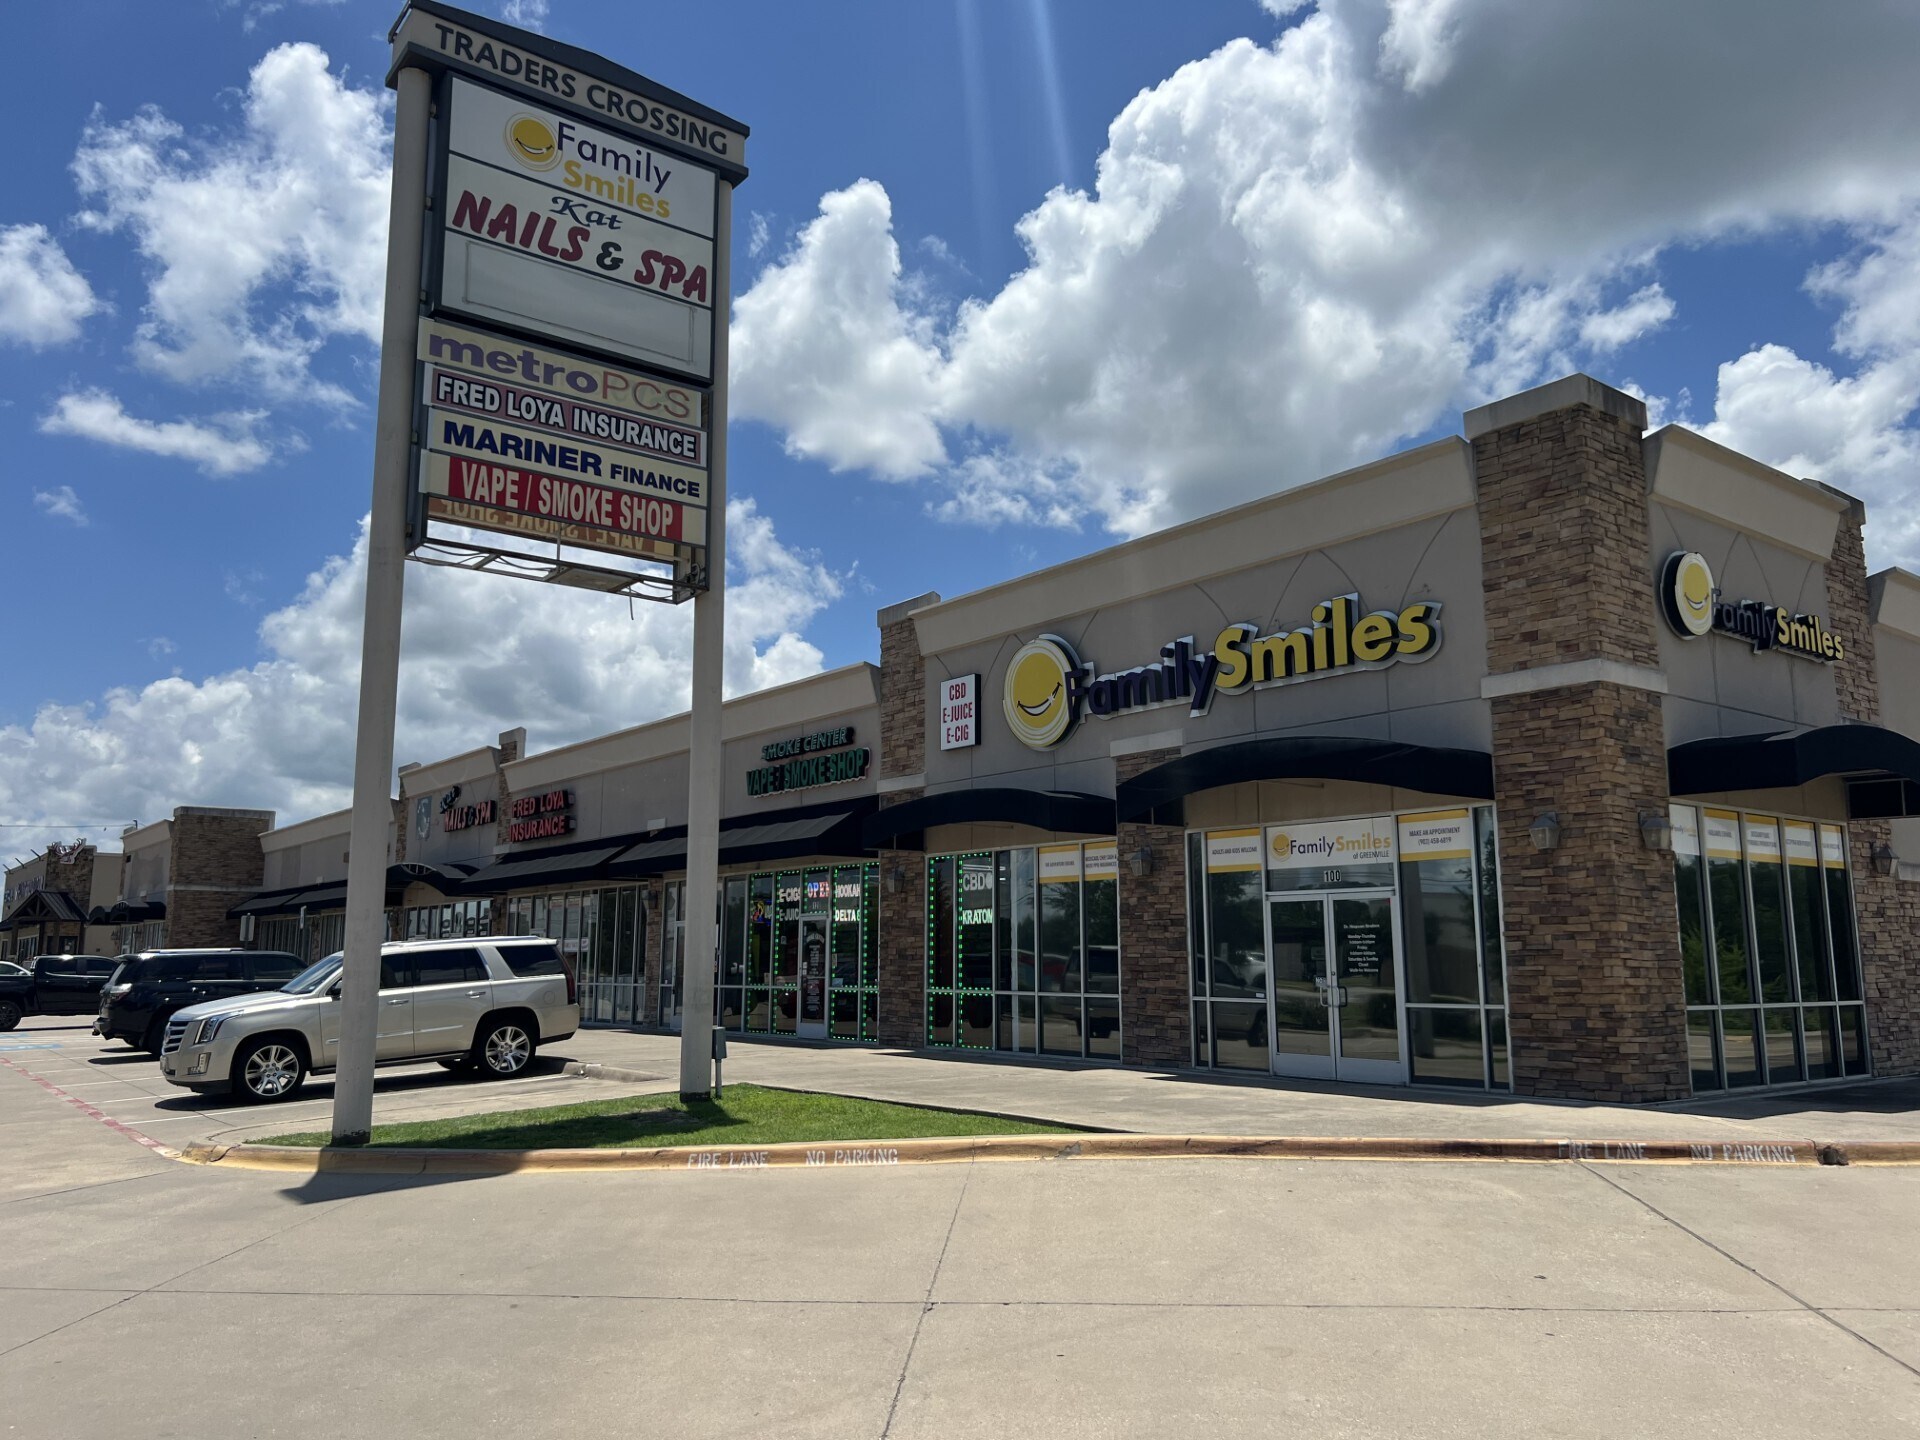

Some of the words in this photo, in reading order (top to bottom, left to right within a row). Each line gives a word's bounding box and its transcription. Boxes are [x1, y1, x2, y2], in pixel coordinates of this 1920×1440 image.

[435, 23, 577, 98] TRADERS
[586, 83, 728, 155] CROSSING
[558, 121, 671, 194] Family
[563, 159, 671, 219] Smiles
[549, 196, 623, 230] Kat
[452, 190, 590, 262] NAILS
[596, 241, 624, 271] &
[634, 249, 708, 302] SPA
[438, 374, 501, 412] FRED
[506, 391, 566, 428] LOYA
[572, 406, 696, 458] INSURANCE
[443, 420, 602, 477] MARINER
[610, 463, 700, 498] FINANCE
[461, 461, 520, 508] VAPE
[524, 474, 533, 511] /
[537, 477, 613, 526] SMOKE
[619, 494, 674, 537] SHOP
[949, 682, 967, 701] CBD
[943, 702, 973, 723] E-JUICE
[761, 737, 801, 761] SMOKE
[803, 727, 849, 751] CENTER
[946, 724, 969, 744] E-CIG
[746, 765, 775, 796] VAPE
[784, 756, 827, 788] SMOKE
[829, 748, 865, 782] SHOP
[444, 806, 468, 832] NAILS
[474, 799, 492, 826] SPA
[511, 796, 537, 817] FRED
[540, 790, 565, 812] LOYA
[508, 815, 566, 842] INSURANCE
[1360, 849, 1390, 859] GREENVILLE
[963, 872, 985, 891] CBD
[1323, 870, 1342, 882] 100
[834, 883, 860, 898] HOOKAH
[780, 907, 800, 921] E-JUIC
[835, 908, 856, 922] DELTA
[962, 908, 993, 925] KRATOM
[687, 1152, 722, 1169] FIRE
[729, 1151, 769, 1168] LANE
[805, 1150, 826, 1166] NO
[833, 1148, 898, 1165] PARKING
[1689, 1144, 1713, 1161] NO
[1721, 1143, 1796, 1163] PARKING
